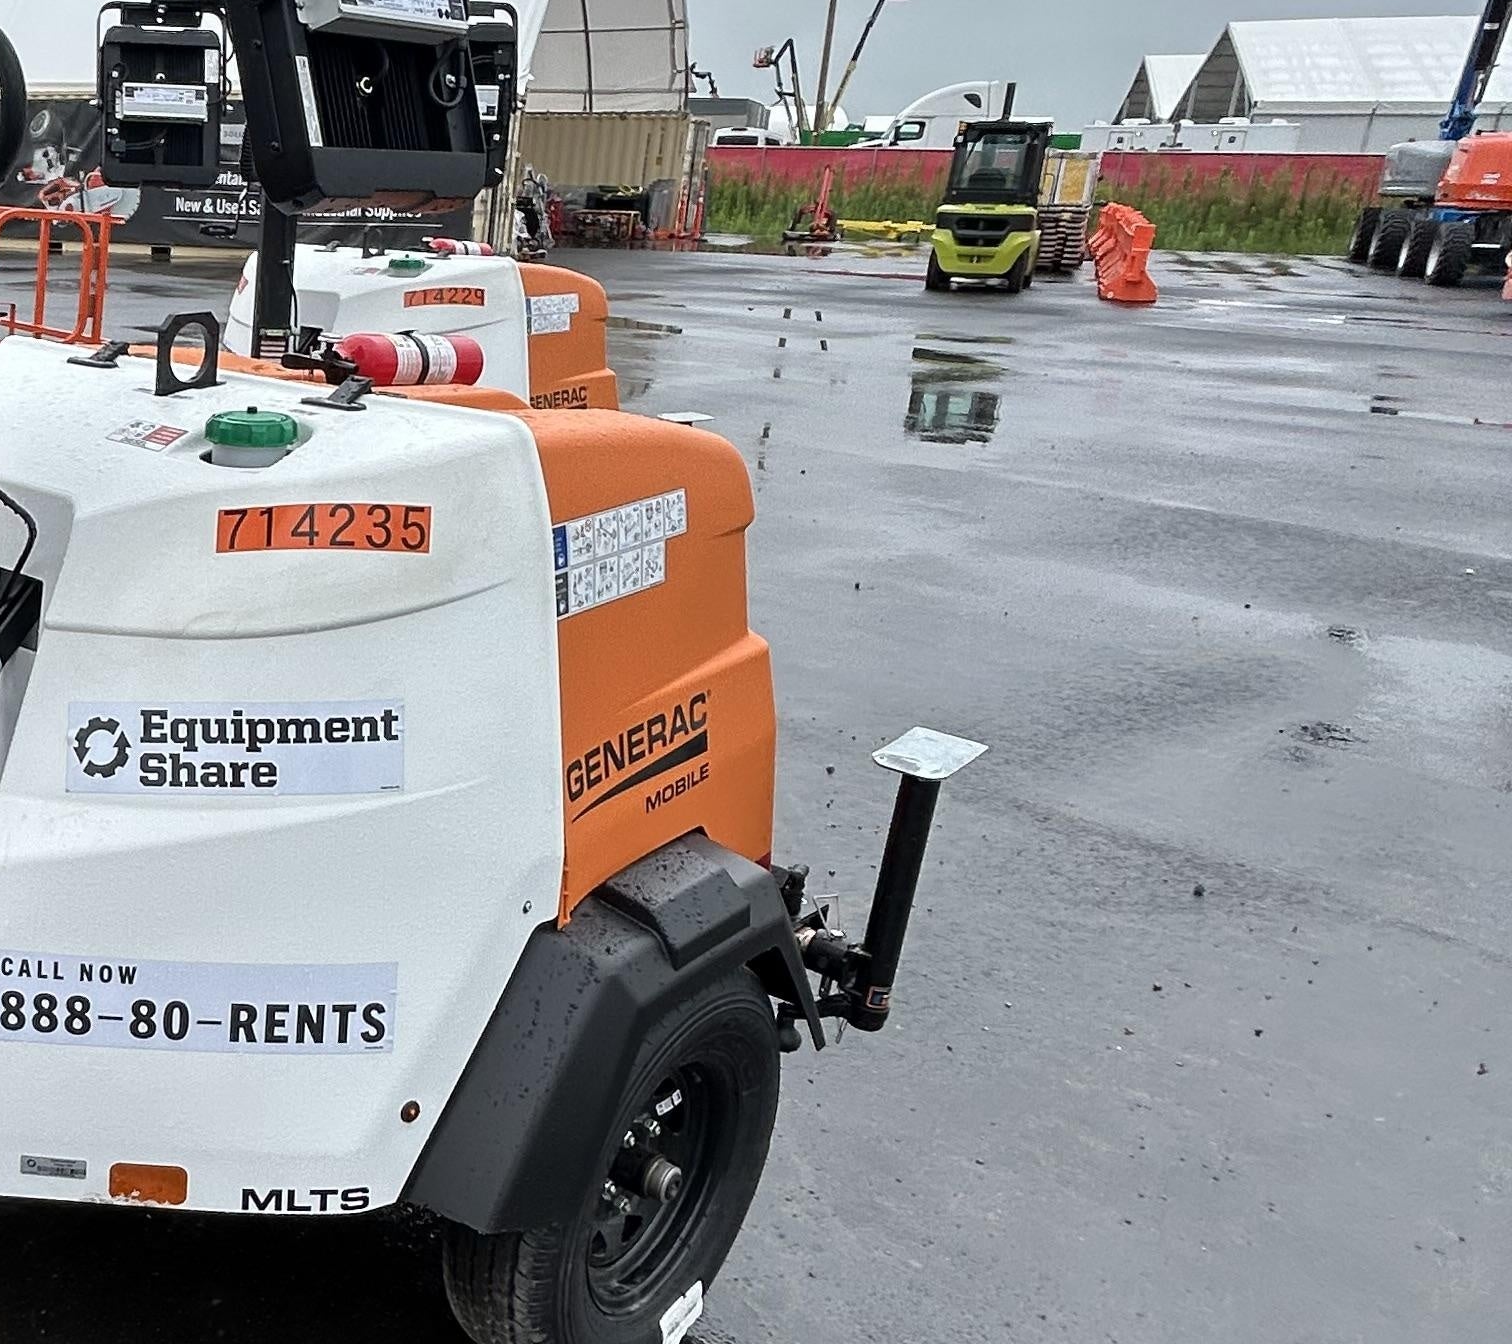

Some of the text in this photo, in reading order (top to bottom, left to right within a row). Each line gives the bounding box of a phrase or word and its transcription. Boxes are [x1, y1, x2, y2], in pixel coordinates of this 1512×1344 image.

[175, 197, 202, 213] New
[202, 198, 214, 214] &
[216, 198, 246, 215] Used
[405, 288, 485, 306] 714229
[224, 503, 426, 550] 714235
[139, 709, 399, 751] Equipment
[566, 692, 708, 803] GENERAC
[139, 753, 278, 788] Share
[645, 762, 710, 813] MOBILE
[1, 957, 138, 985] CALL NOW
[0, 990, 386, 1044] 888-80-RENTS
[241, 1187, 370, 1212] MLTS
